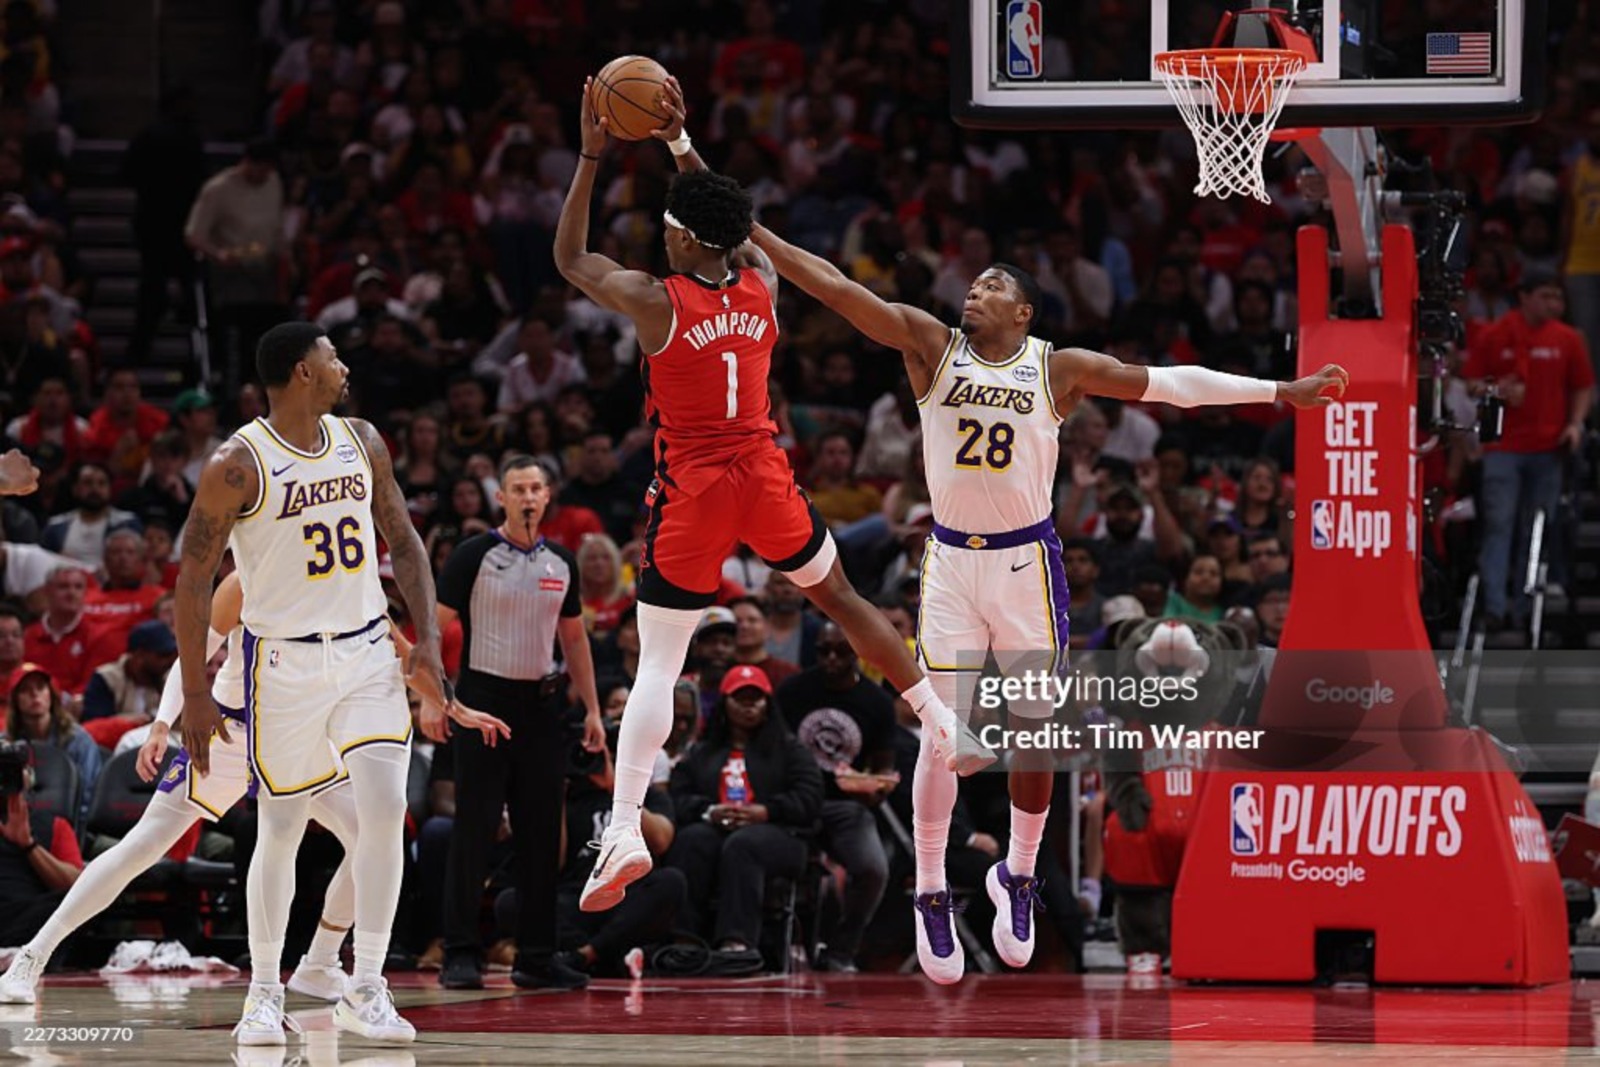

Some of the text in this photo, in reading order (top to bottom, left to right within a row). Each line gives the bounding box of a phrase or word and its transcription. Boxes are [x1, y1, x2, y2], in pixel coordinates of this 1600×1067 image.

[682, 312, 768, 351] THOMPSON
[721, 351, 738, 419] 1
[955, 417, 1015, 471] 28
[1325, 401, 1379, 447] GET
[1324, 451, 1379, 496] THE
[303, 516, 366, 578] 36
[1336, 501, 1391, 558] App
[1306, 678, 1394, 709] Google
[1165, 768, 1192, 796] 00
[1268, 784, 1467, 856] PLAYOFFS
[1287, 859, 1365, 887] Google
